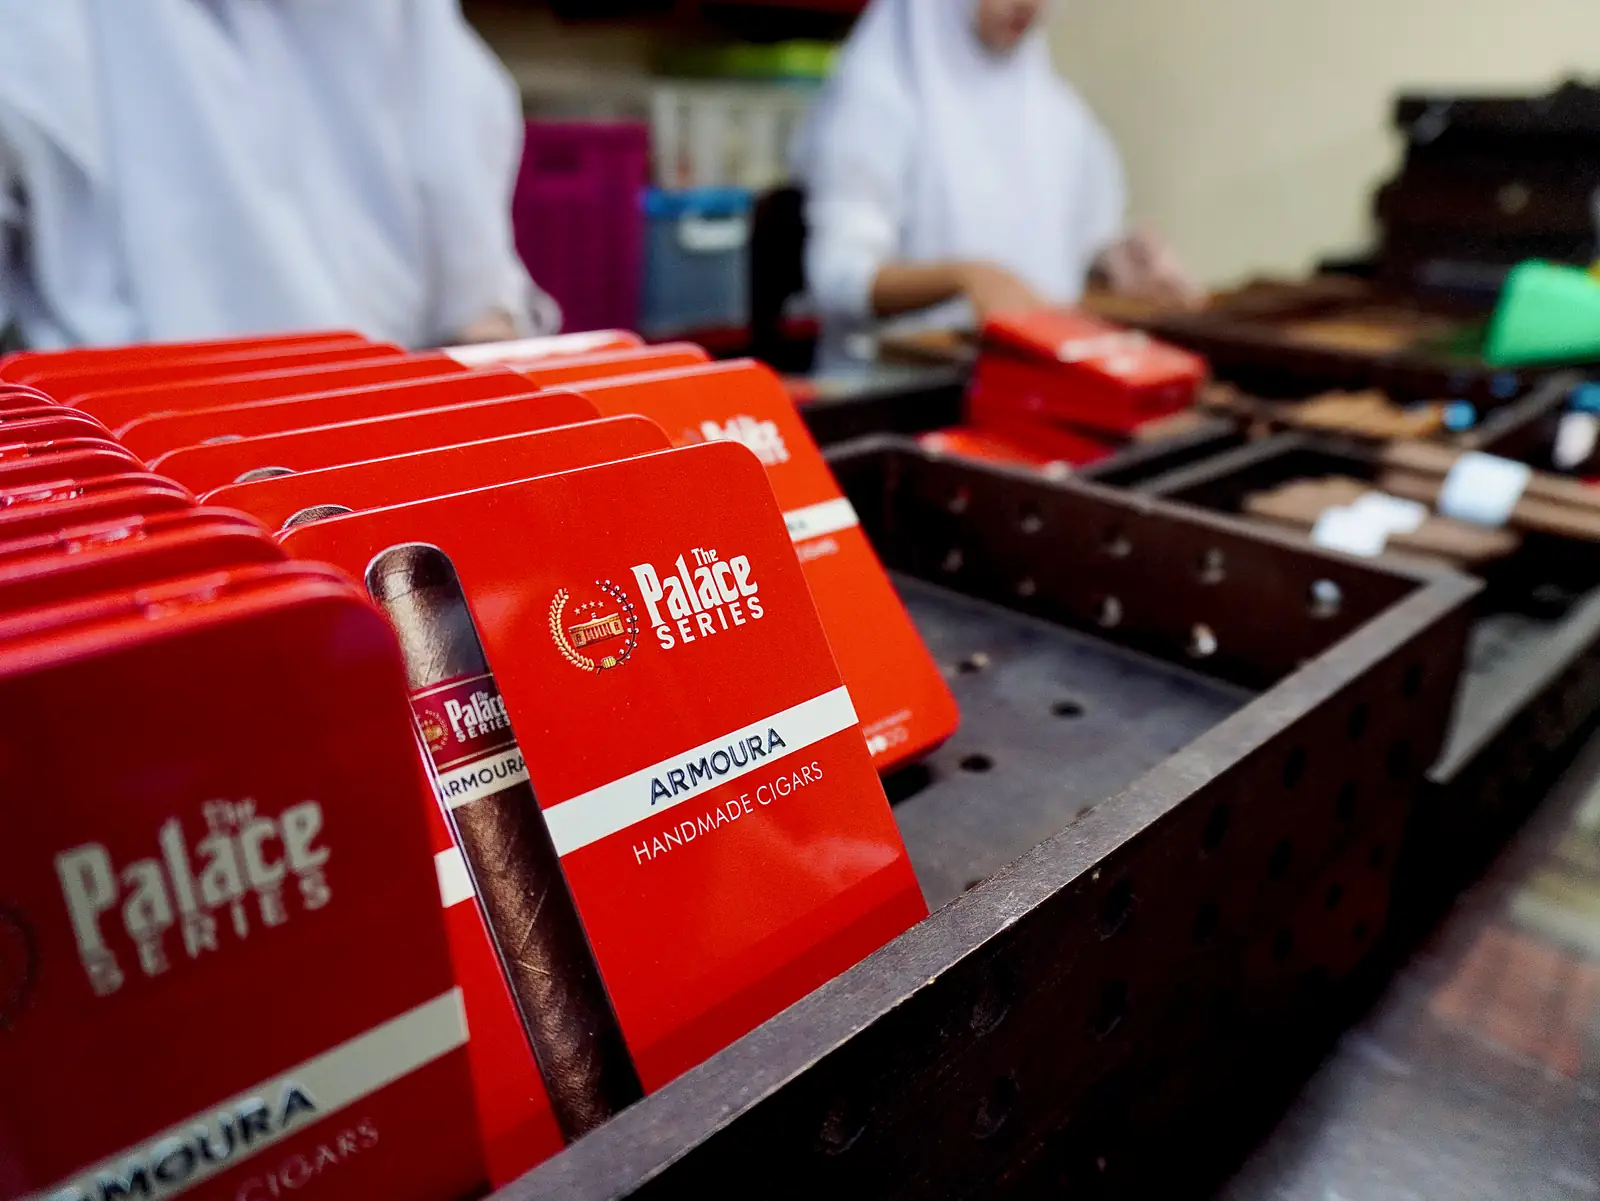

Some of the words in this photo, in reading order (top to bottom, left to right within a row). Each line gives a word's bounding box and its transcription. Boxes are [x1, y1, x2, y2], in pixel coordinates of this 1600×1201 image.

[630, 553, 759, 629] Palace
[691, 547, 719, 565] The
[655, 596, 765, 650] SERIES
[455, 714, 510, 743] SERIES
[650, 727, 787, 806] ARMOURA
[632, 793, 754, 865] HANDMADE
[755, 761, 824, 806] CIGARS
[53, 799, 330, 956] Palace
[89, 864, 331, 996] SERIES
